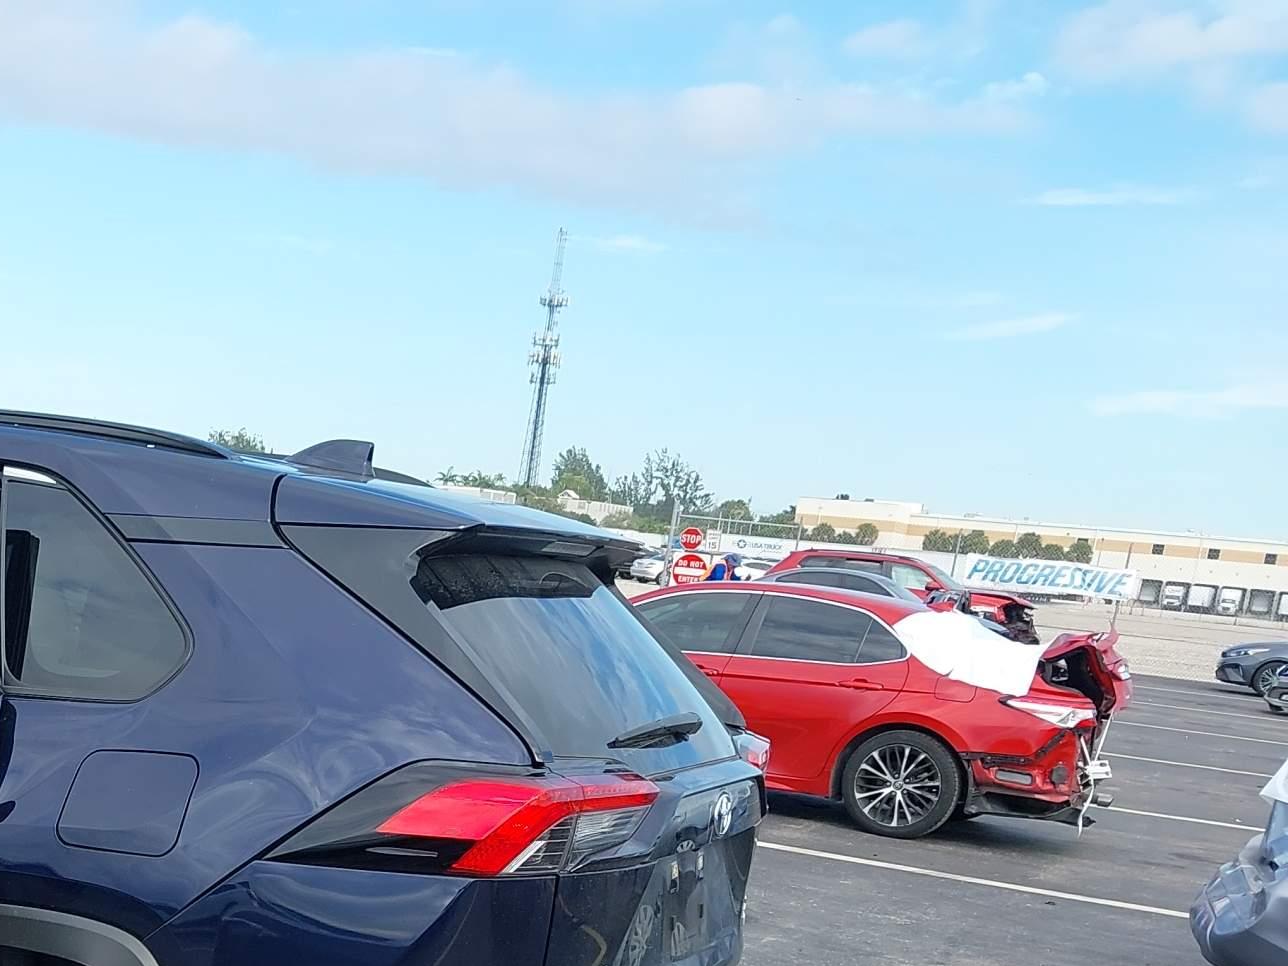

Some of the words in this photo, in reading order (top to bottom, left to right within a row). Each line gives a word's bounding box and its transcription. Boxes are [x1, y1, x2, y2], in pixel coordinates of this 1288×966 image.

[680, 535, 702, 544] STOP
[708, 541, 717, 550] 15
[690, 561, 705, 569] NOT
[966, 558, 1132, 596] PROGRESSIVE
